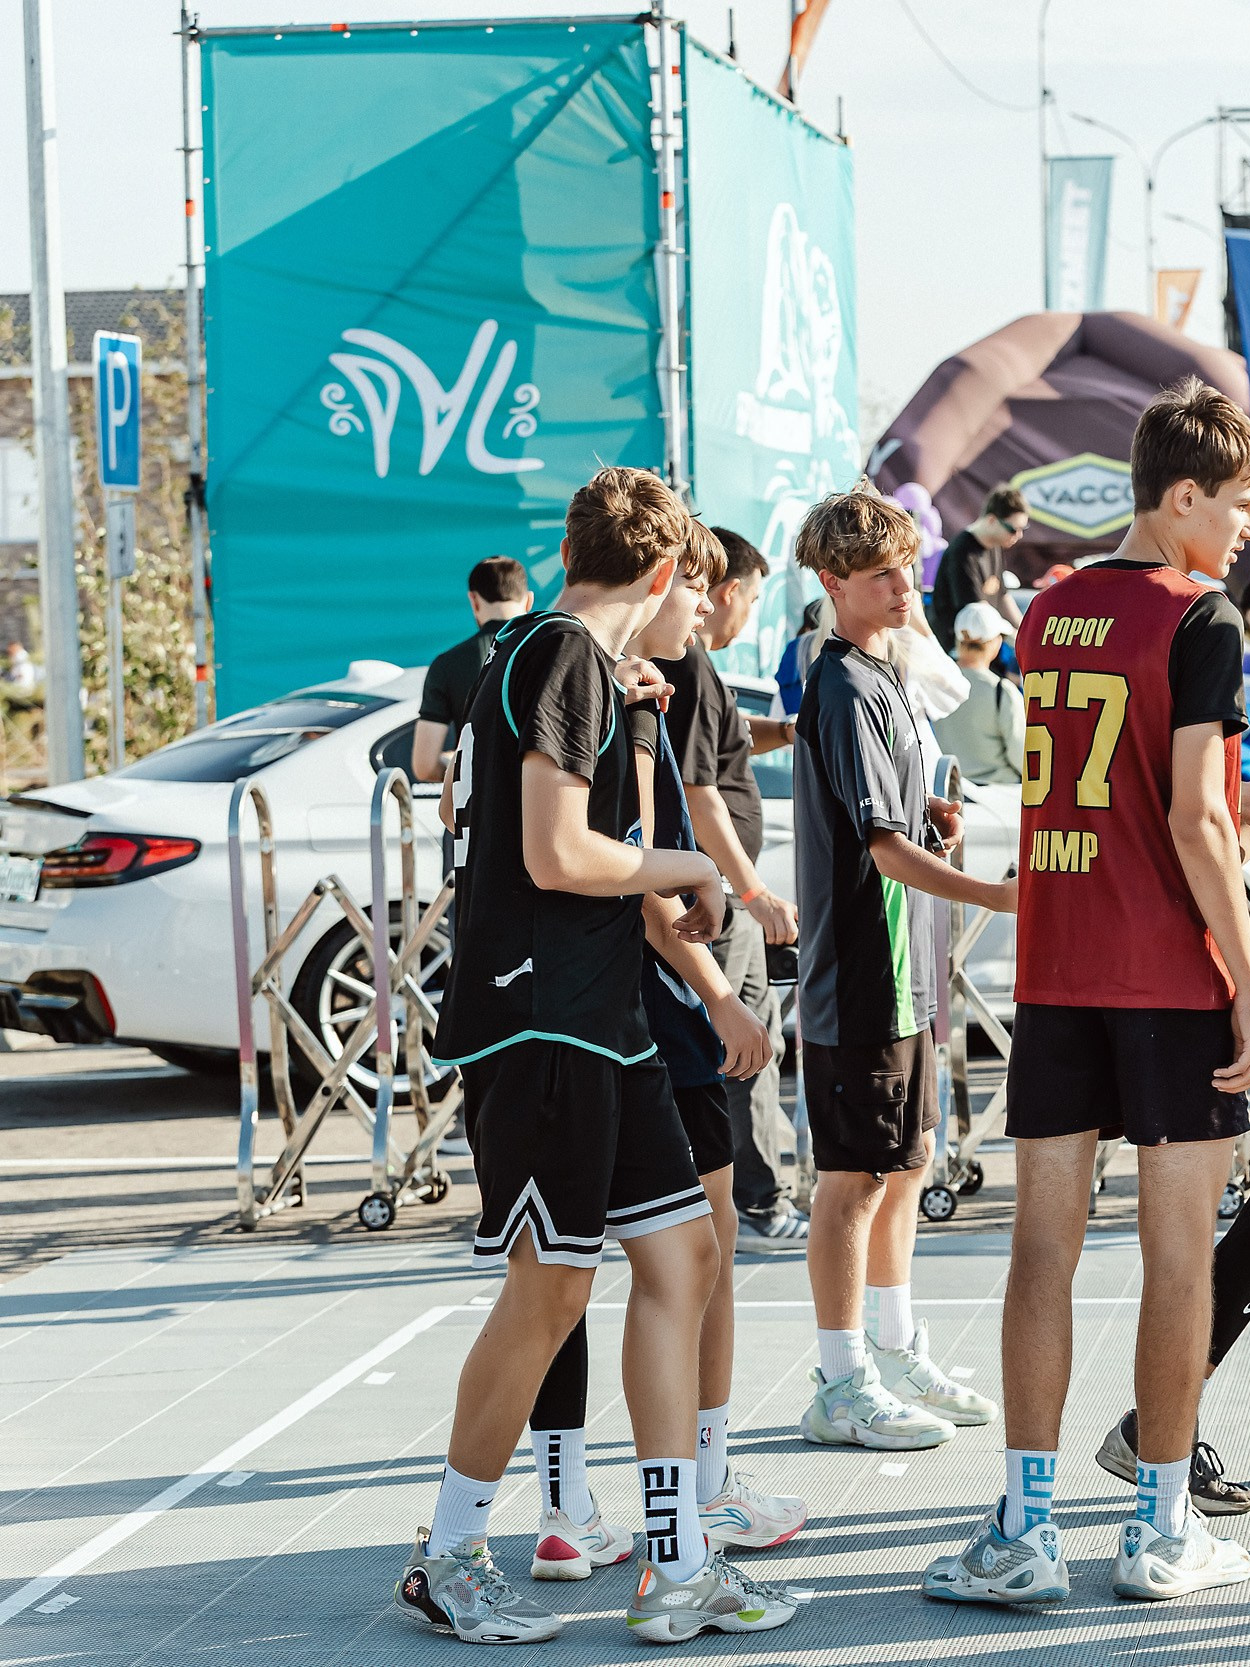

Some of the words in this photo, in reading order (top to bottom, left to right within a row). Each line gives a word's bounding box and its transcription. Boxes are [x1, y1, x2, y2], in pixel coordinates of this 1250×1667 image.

[107, 351, 132, 471] P
[1041, 616, 1115, 647] POPOV
[1021, 669, 1132, 809] 67
[1029, 830, 1099, 874] JUMP
